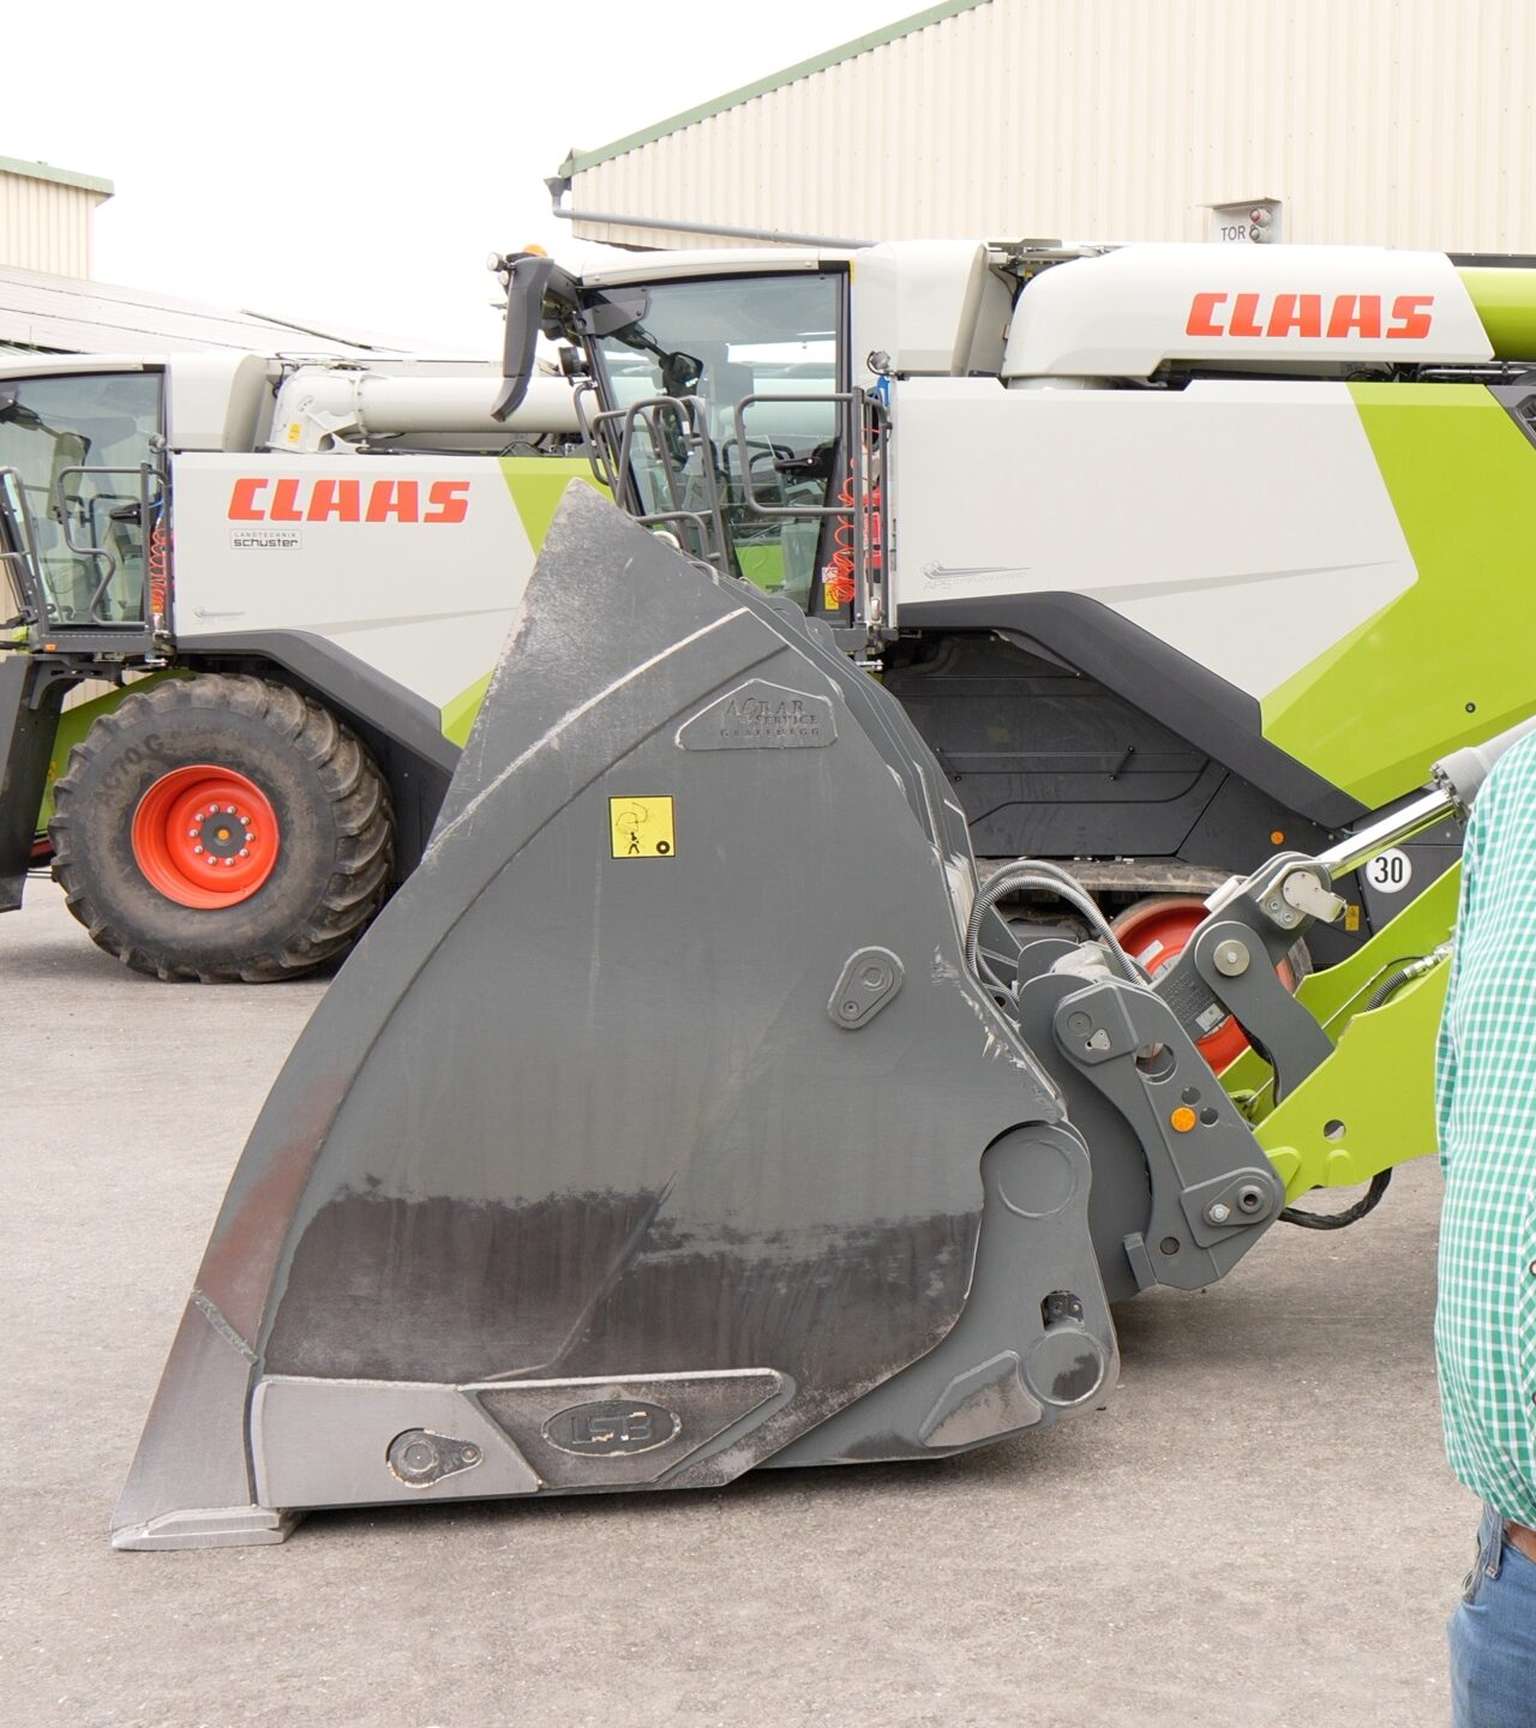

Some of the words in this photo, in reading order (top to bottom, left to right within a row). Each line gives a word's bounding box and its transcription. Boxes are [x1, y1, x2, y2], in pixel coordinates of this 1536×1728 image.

[1221, 225, 1246, 241] TOR
[1185, 293, 1435, 339] CLAAS
[227, 478, 471, 523] CLAAS
[233, 539, 299, 547] schuster
[1374, 856, 1403, 883] 30
